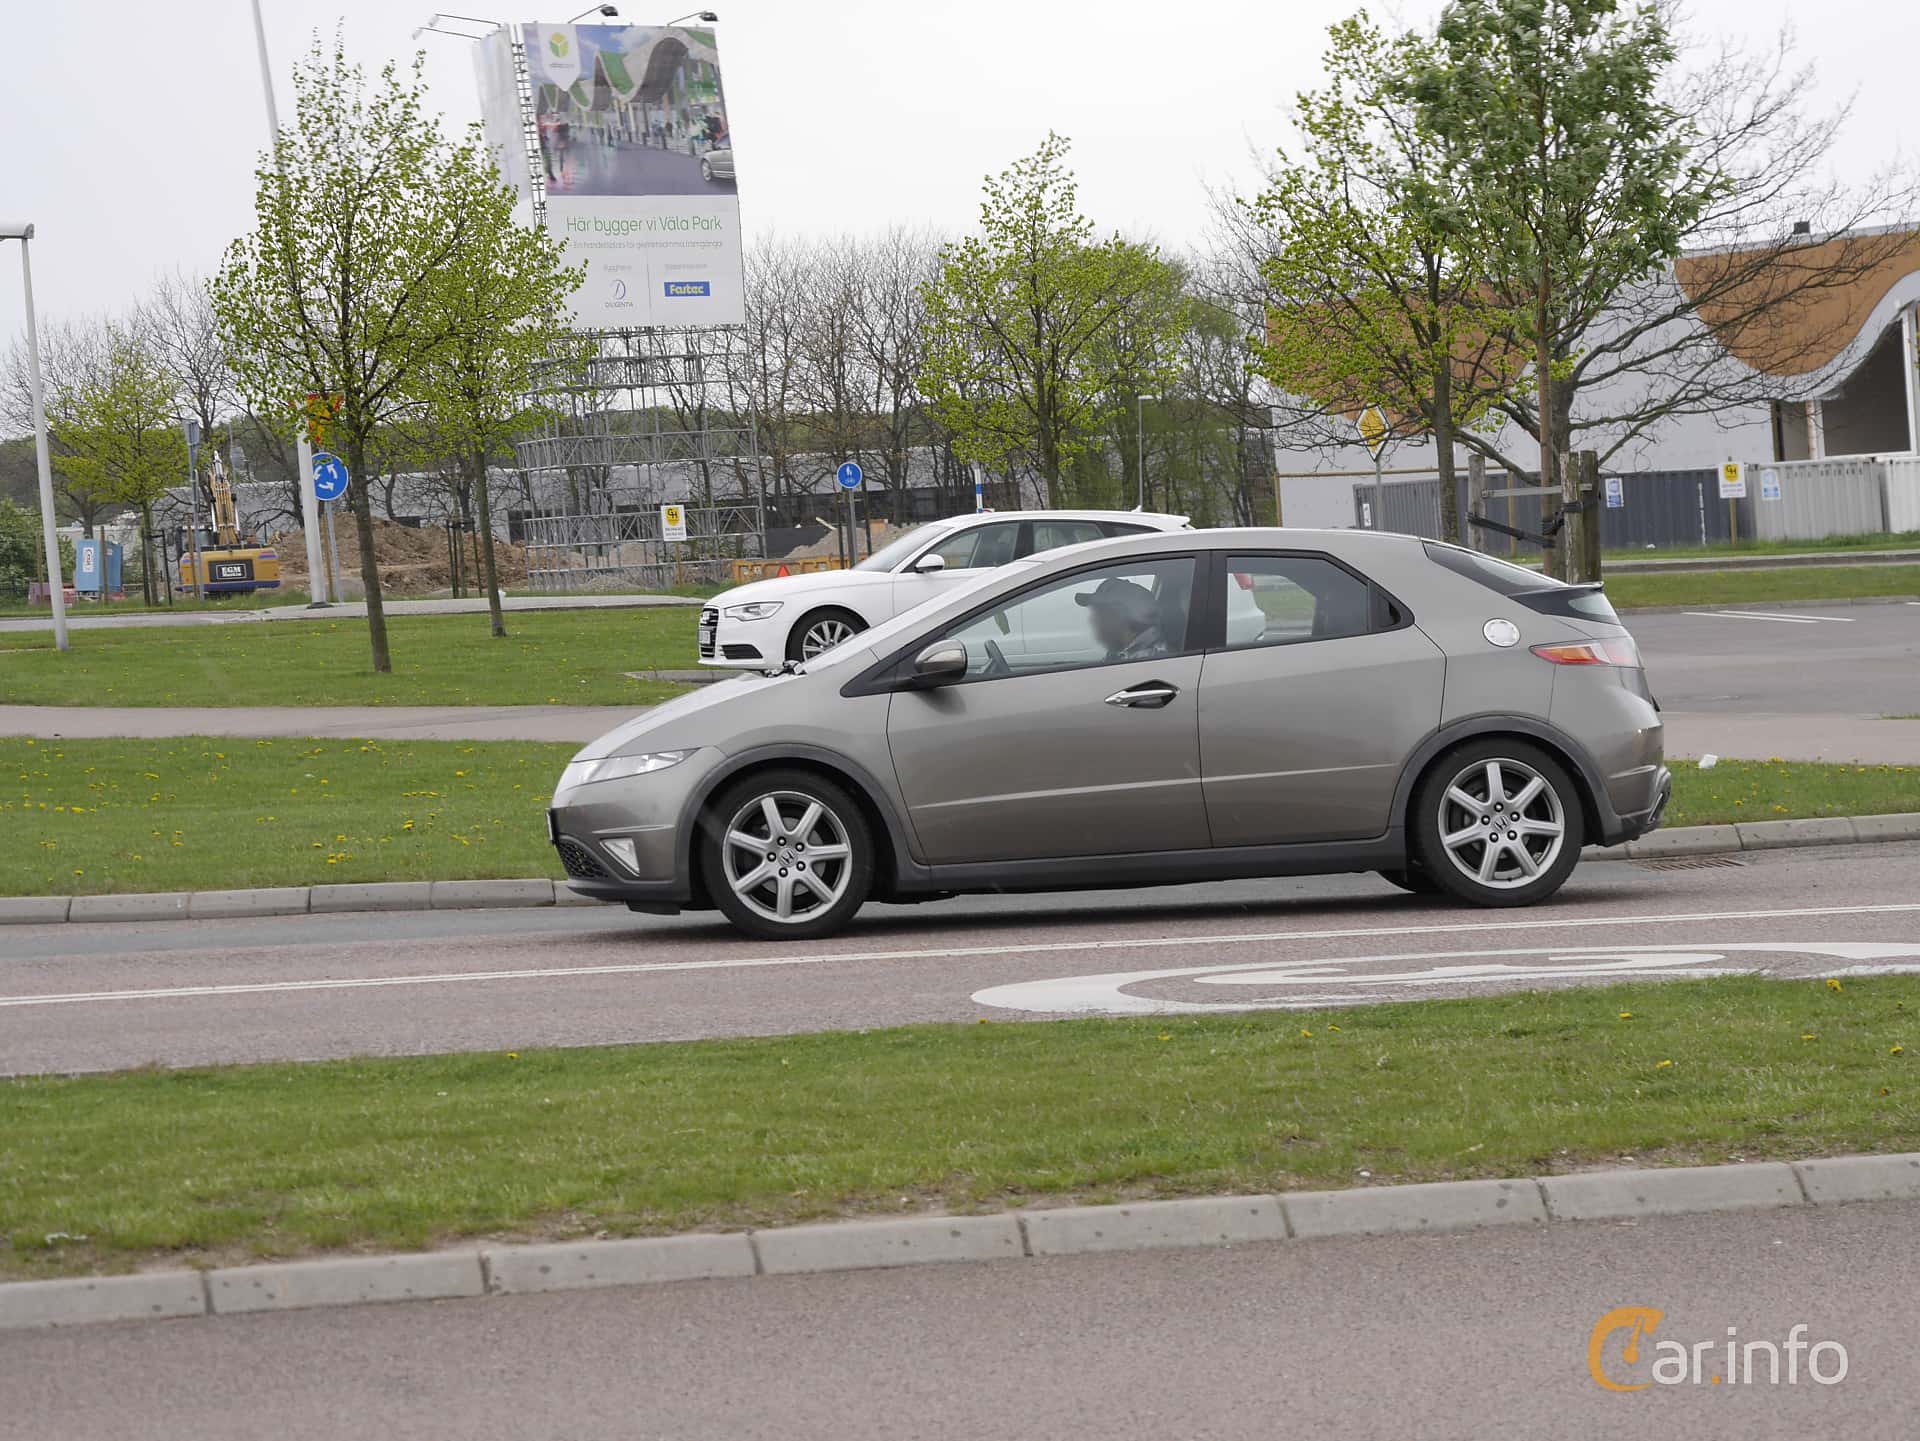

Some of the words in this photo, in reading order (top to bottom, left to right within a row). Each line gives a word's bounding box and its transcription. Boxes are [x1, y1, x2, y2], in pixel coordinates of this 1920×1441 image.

[566, 216, 591, 232] Här
[594, 216, 643, 236] bygger
[646, 217, 657, 231] vi
[658, 215, 689, 231] Väla
[692, 215, 723, 231] Park
